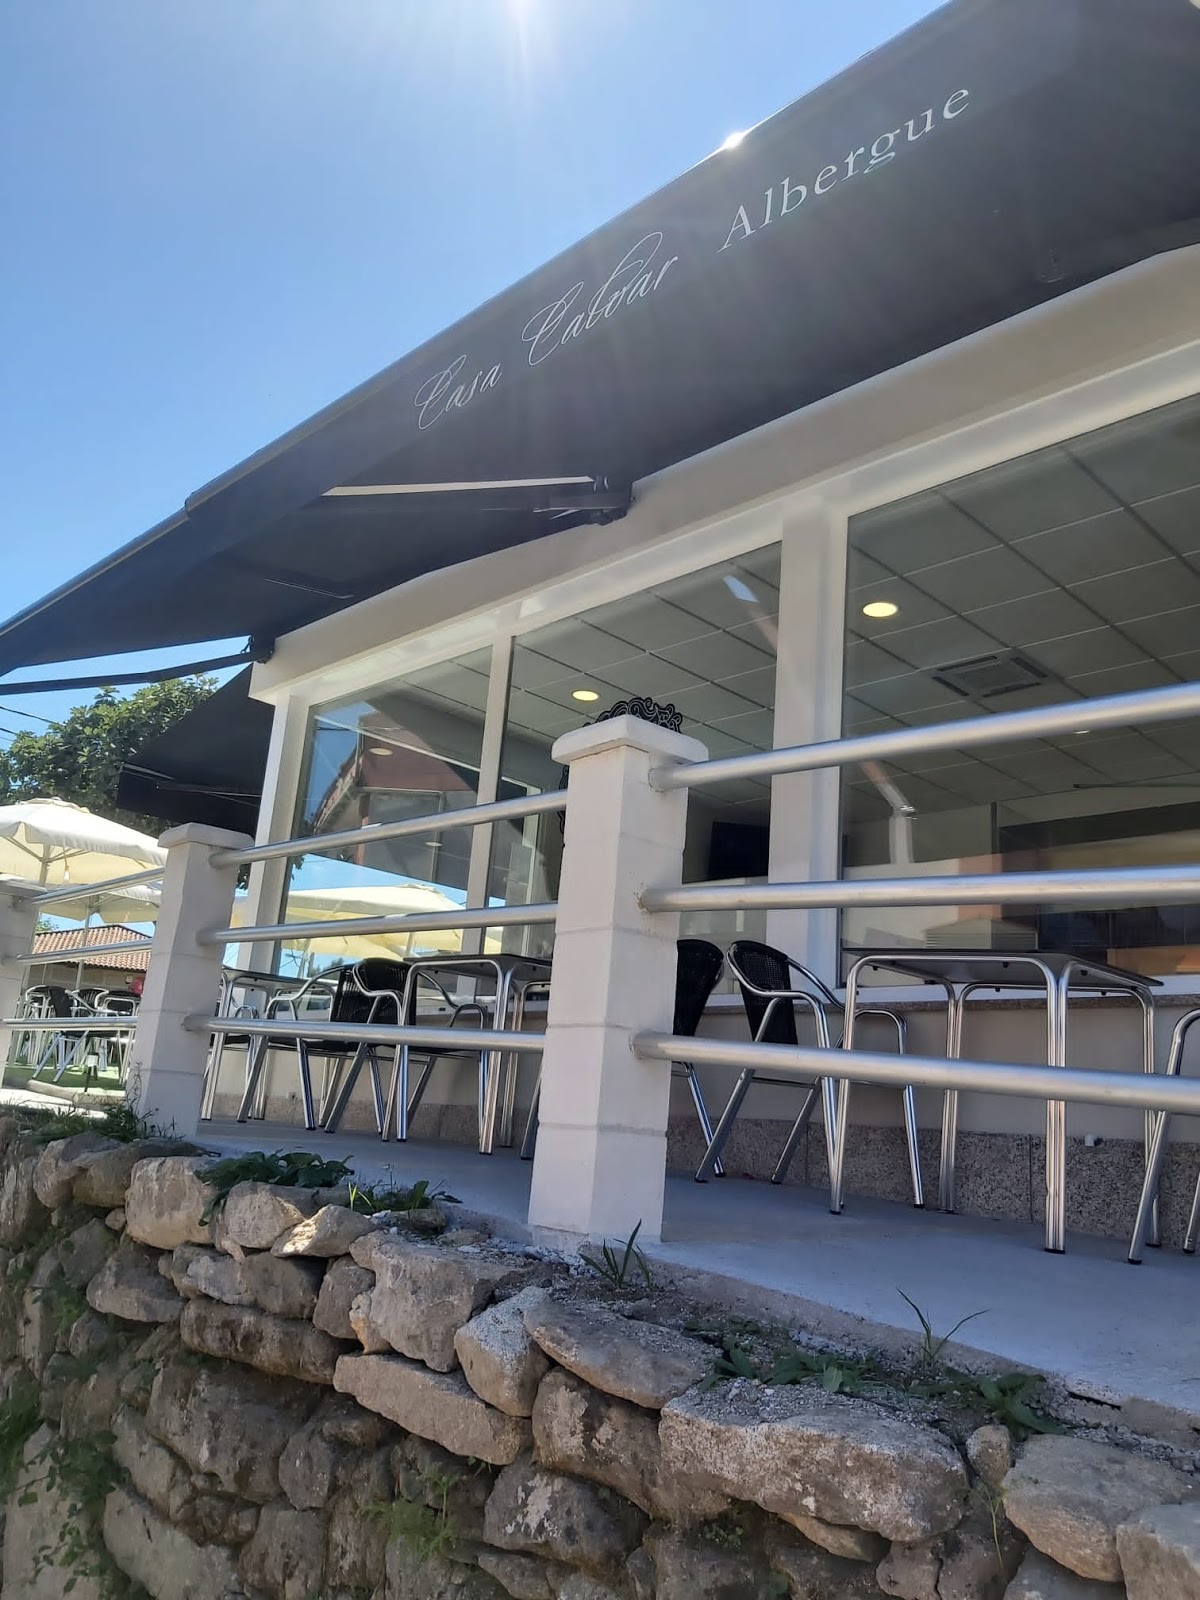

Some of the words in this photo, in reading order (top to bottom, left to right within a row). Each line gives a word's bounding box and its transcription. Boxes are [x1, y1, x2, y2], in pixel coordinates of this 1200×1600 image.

[415, 354, 502, 430] Casa
[522, 231, 679, 366] Calvar
[717, 89, 969, 253] Albergue
